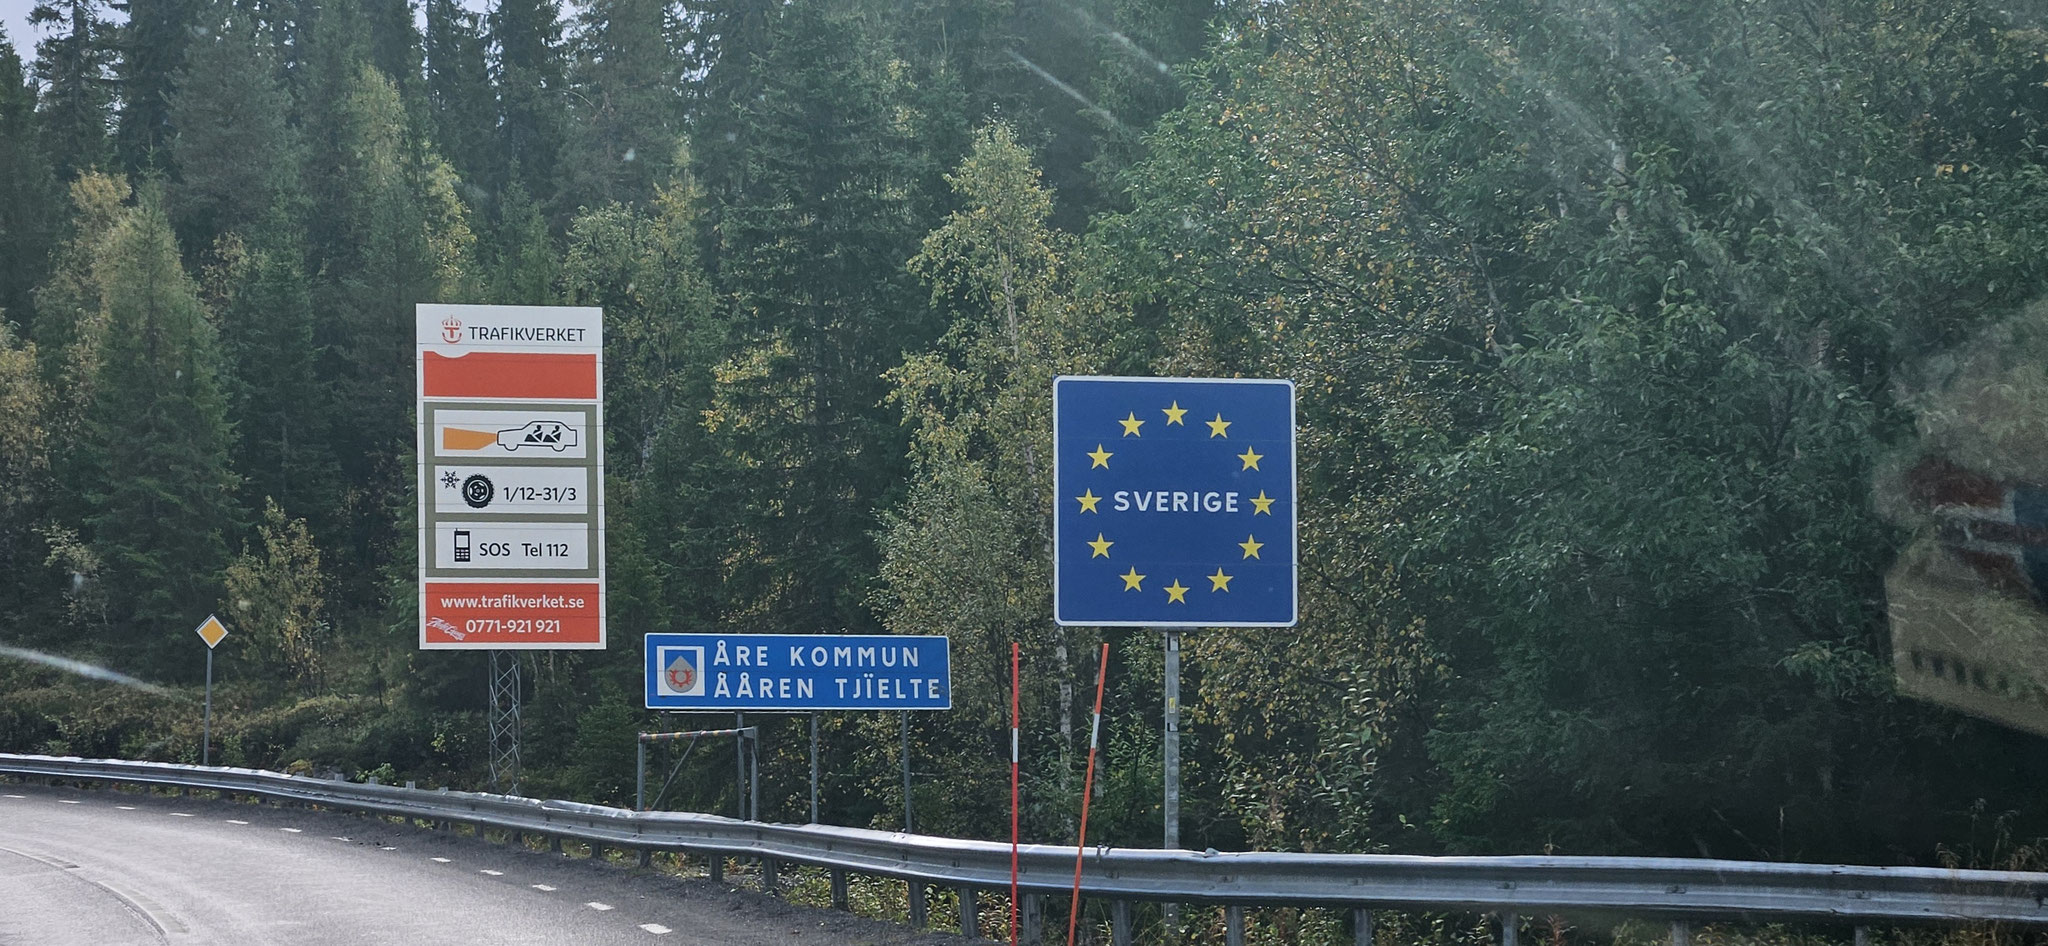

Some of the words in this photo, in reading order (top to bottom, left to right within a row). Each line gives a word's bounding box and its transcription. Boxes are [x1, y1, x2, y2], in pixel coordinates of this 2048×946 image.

[468, 326, 586, 342] TRAFIKVERKET
[503, 487, 577, 503] 1/12-31/3
[1113, 490, 1239, 513] SVERIGE
[479, 543, 511, 557] SOS
[521, 543, 542, 557] Tel
[546, 543, 569, 557] 112
[440, 594, 585, 609] www.trafikverket.se
[465, 619, 532, 633] 0771-921
[535, 619, 561, 633] 921
[713, 640, 769, 667] ÅRE
[790, 646, 919, 667] KOMMUN
[713, 672, 814, 698] ÅÅREN
[835, 673, 941, 699] TJÏELTE
